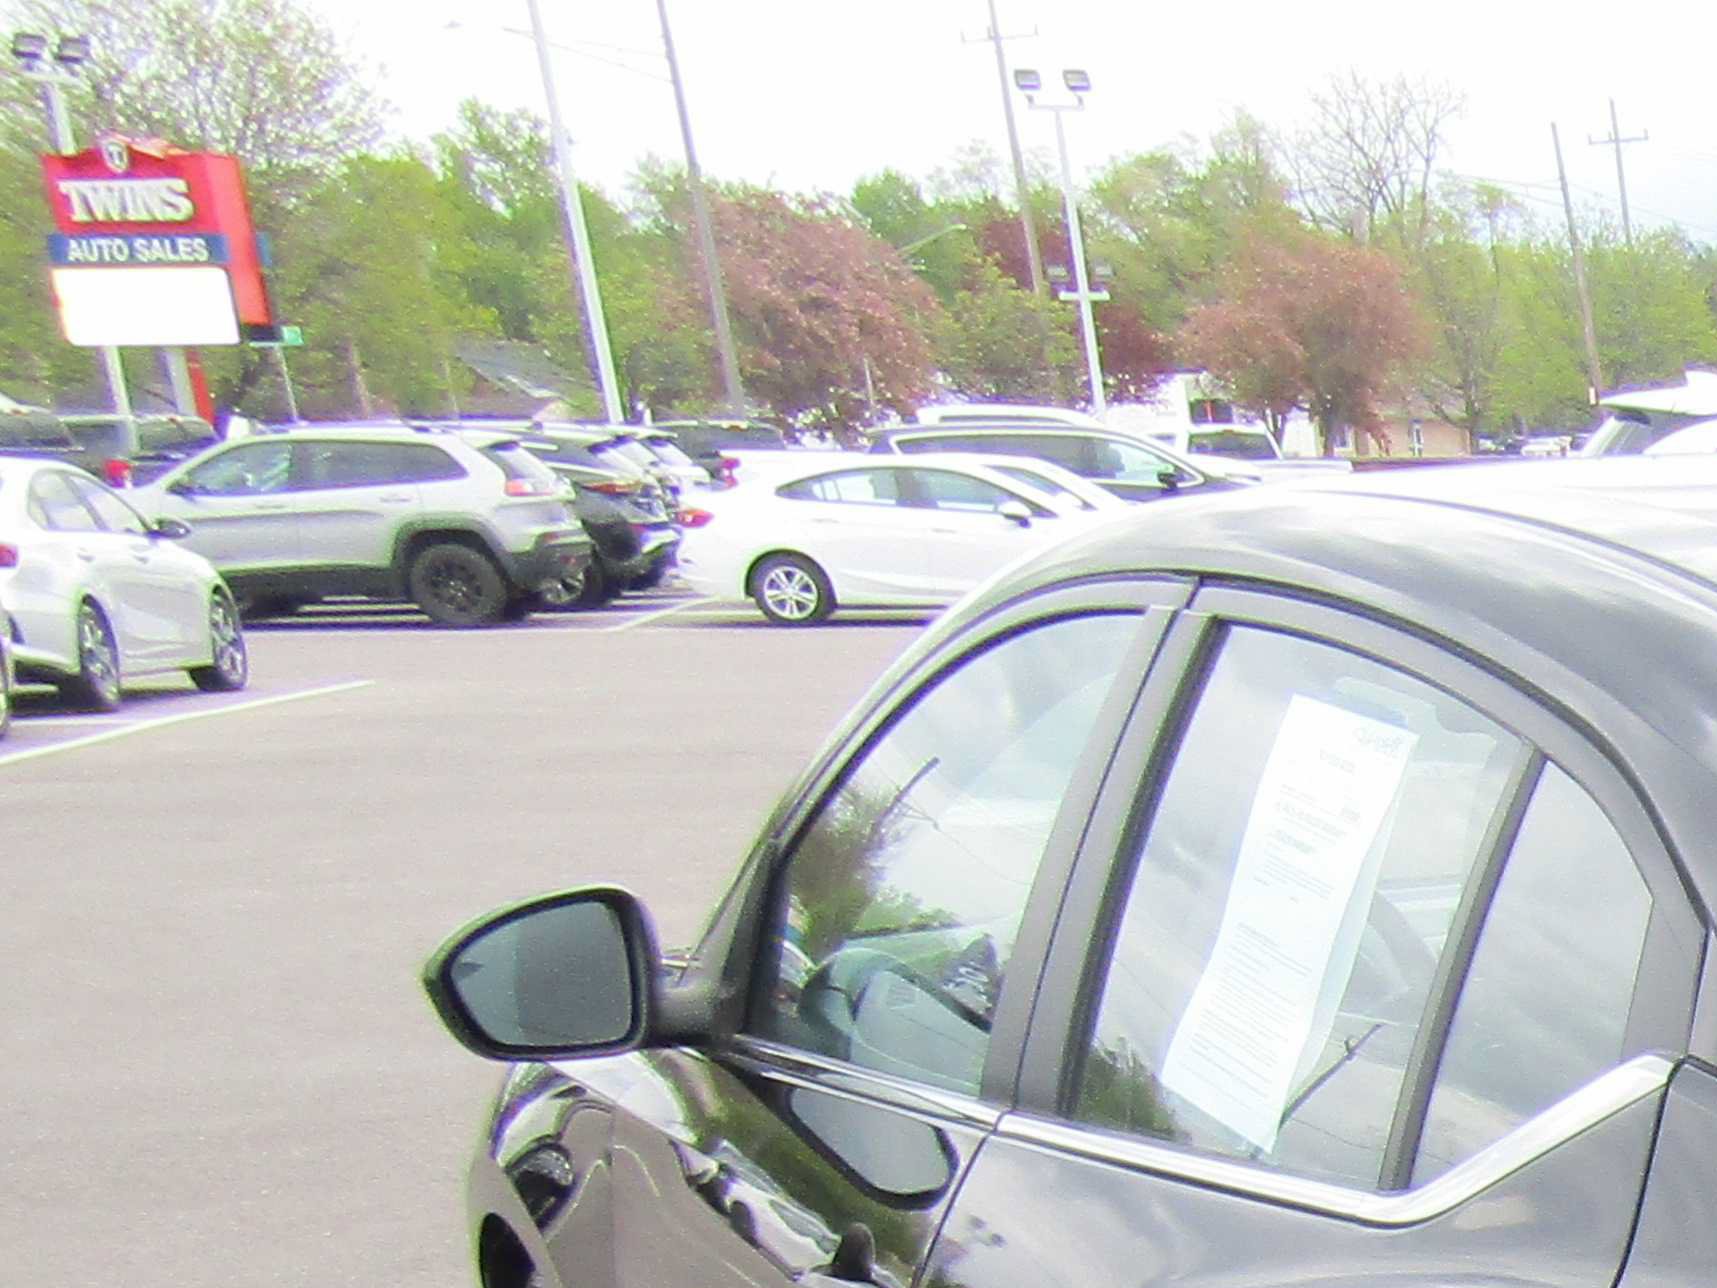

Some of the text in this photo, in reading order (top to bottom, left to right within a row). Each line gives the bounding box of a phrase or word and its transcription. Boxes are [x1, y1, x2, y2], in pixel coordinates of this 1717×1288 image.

[55, 178, 196, 223] TWINS
[67, 236, 210, 263] AUTO SALES
